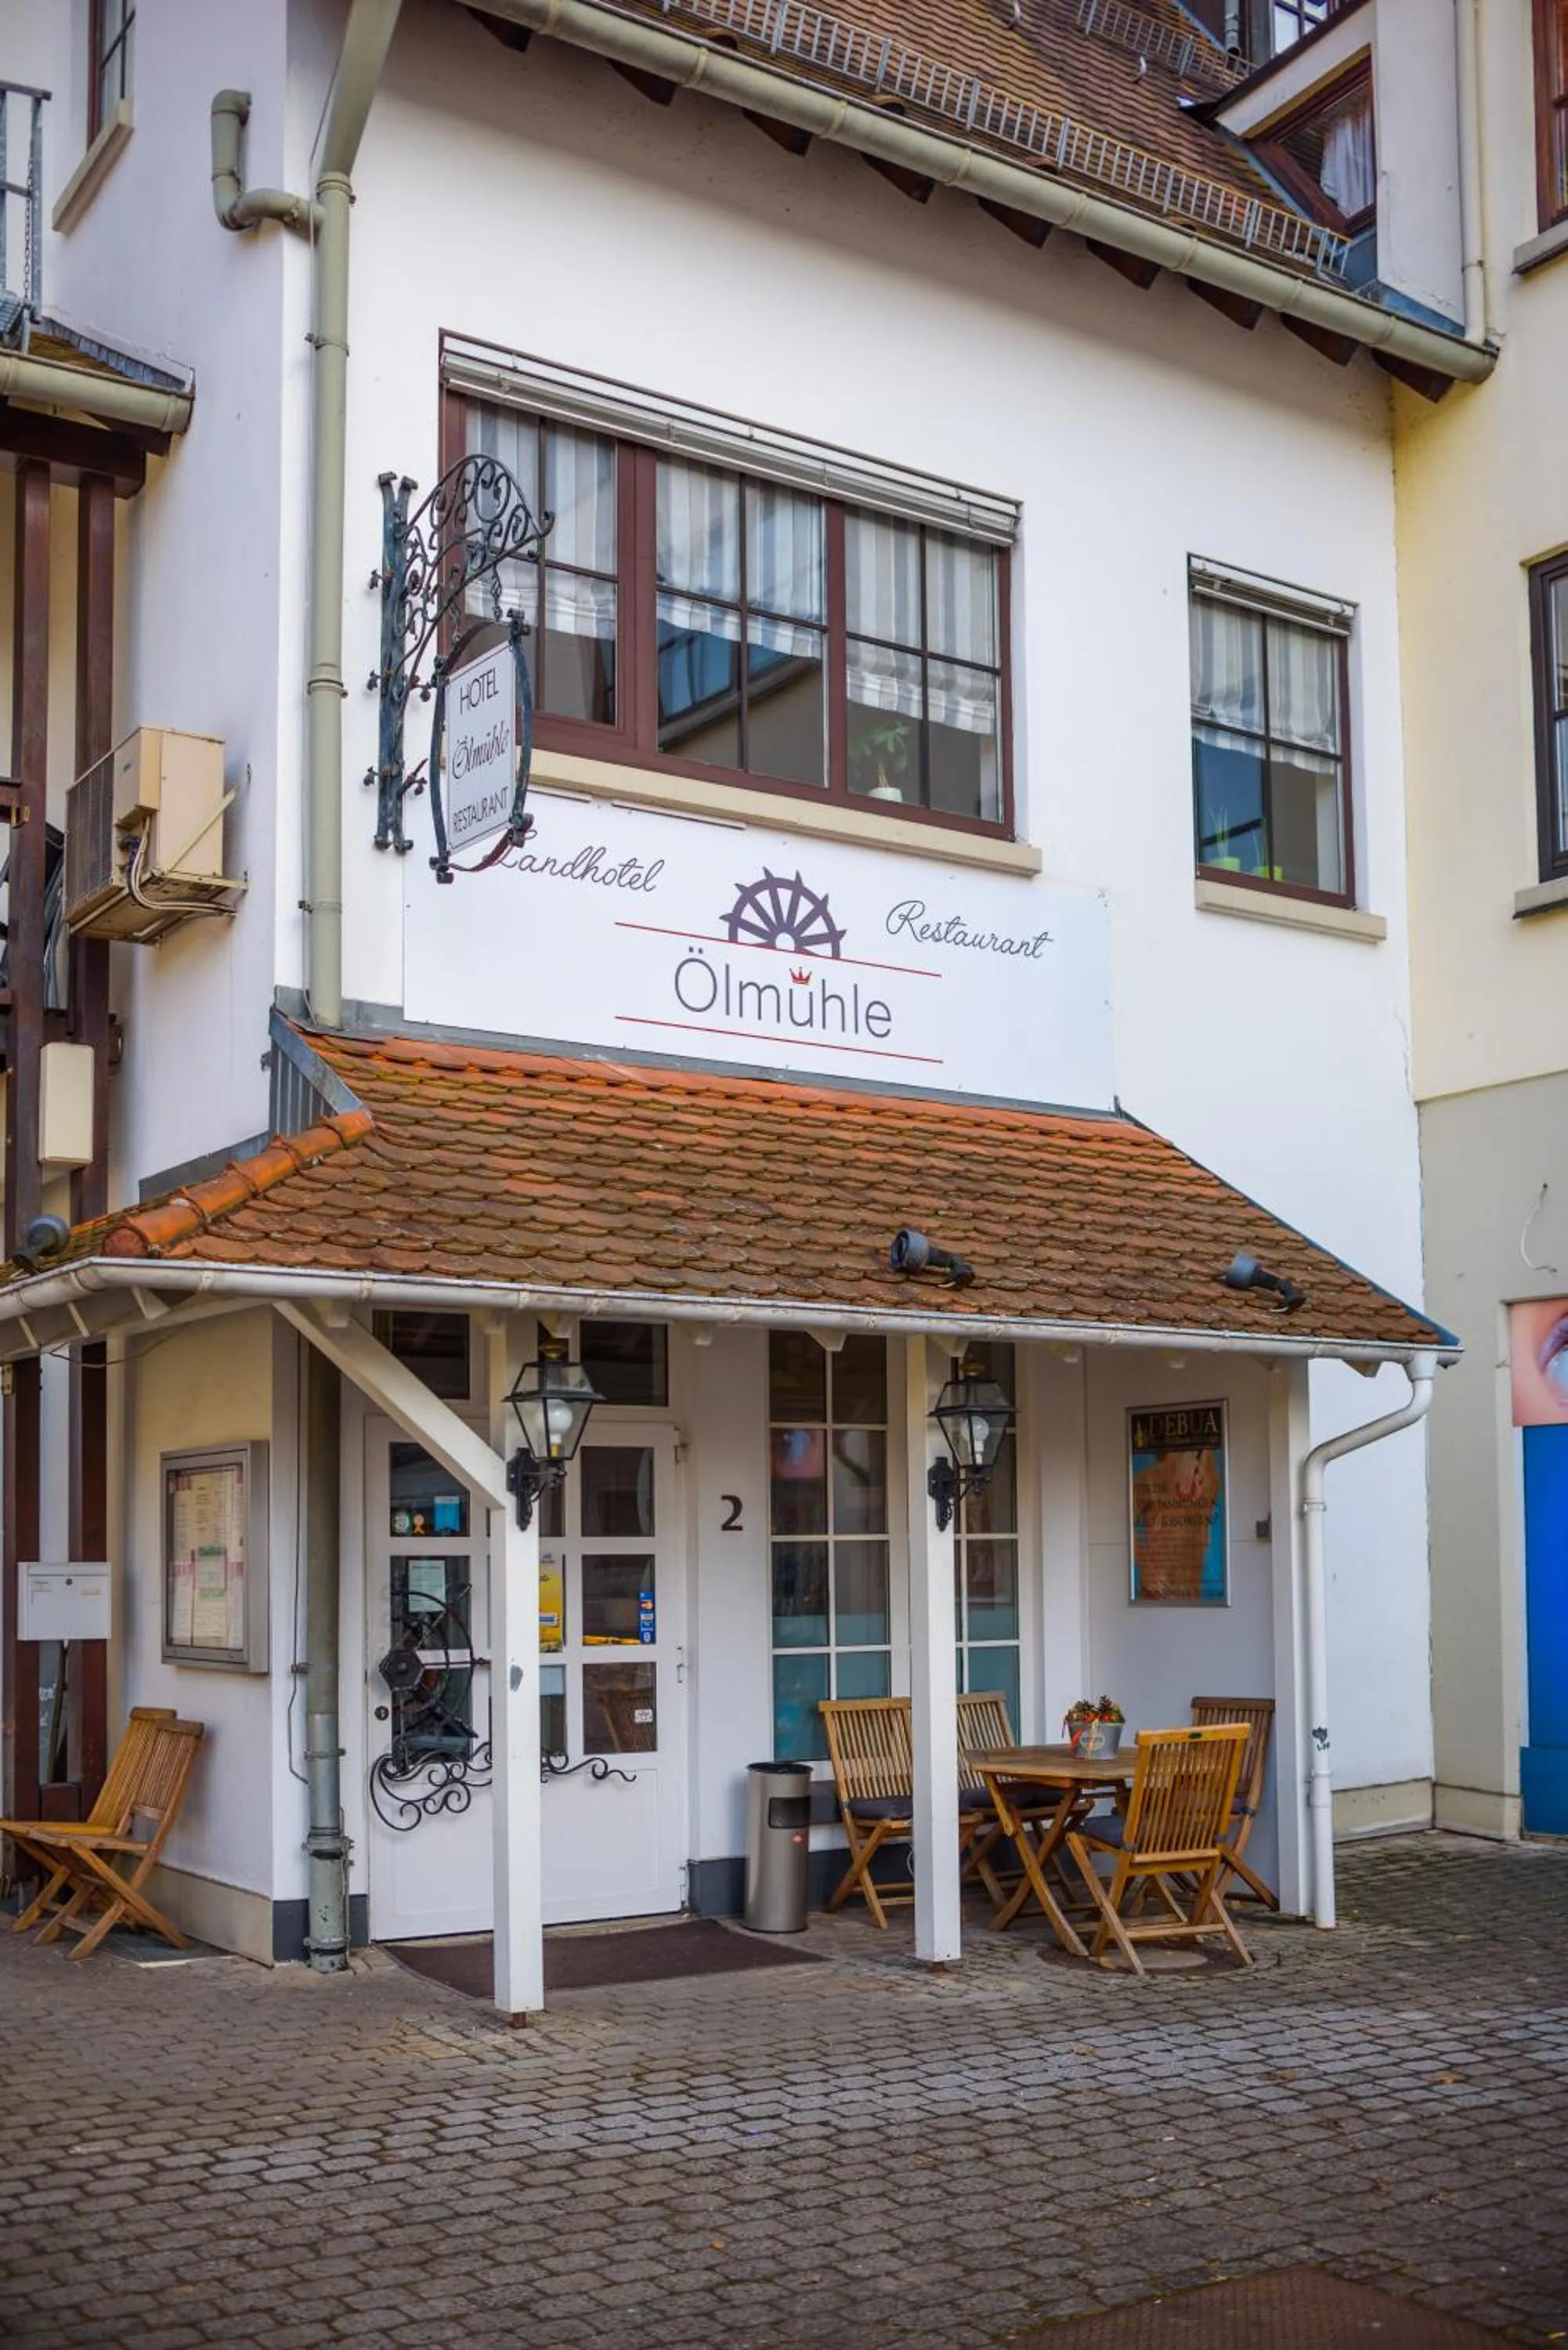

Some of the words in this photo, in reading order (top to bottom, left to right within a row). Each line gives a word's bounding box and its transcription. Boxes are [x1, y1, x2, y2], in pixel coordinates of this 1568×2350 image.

[460, 667, 499, 715] HOTEL
[452, 720, 510, 779] Ölmühle
[453, 786, 509, 833] RESTAURANT
[885, 899, 1053, 960] Restaurant
[721, 1495, 743, 1531] 2
